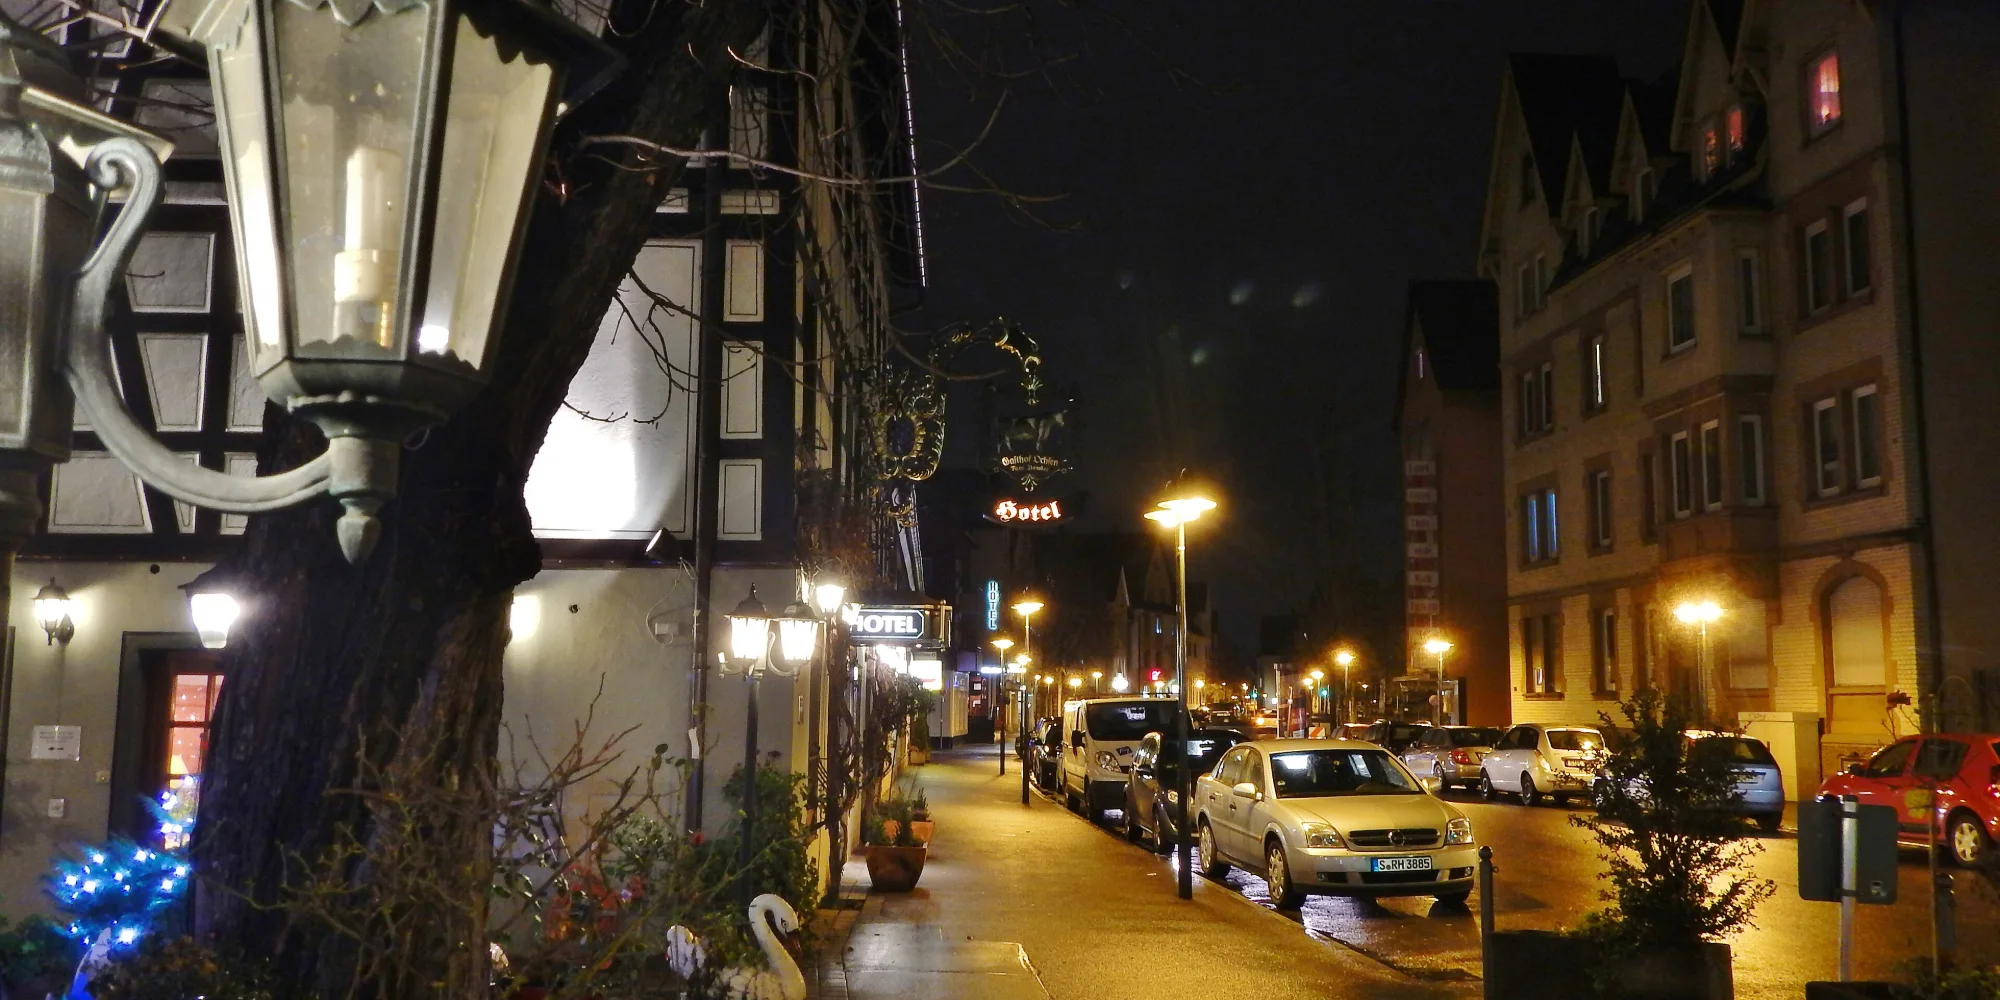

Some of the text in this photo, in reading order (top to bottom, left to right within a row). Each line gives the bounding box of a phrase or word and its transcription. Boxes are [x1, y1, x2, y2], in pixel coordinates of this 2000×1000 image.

[1001, 455, 1032, 467] Gasthof
[996, 500, 1061, 522] Hotel
[989, 581, 998, 630] HOTEL
[854, 614, 918, 633] HOTEL
[1406, 858, 1430, 869] 3885
